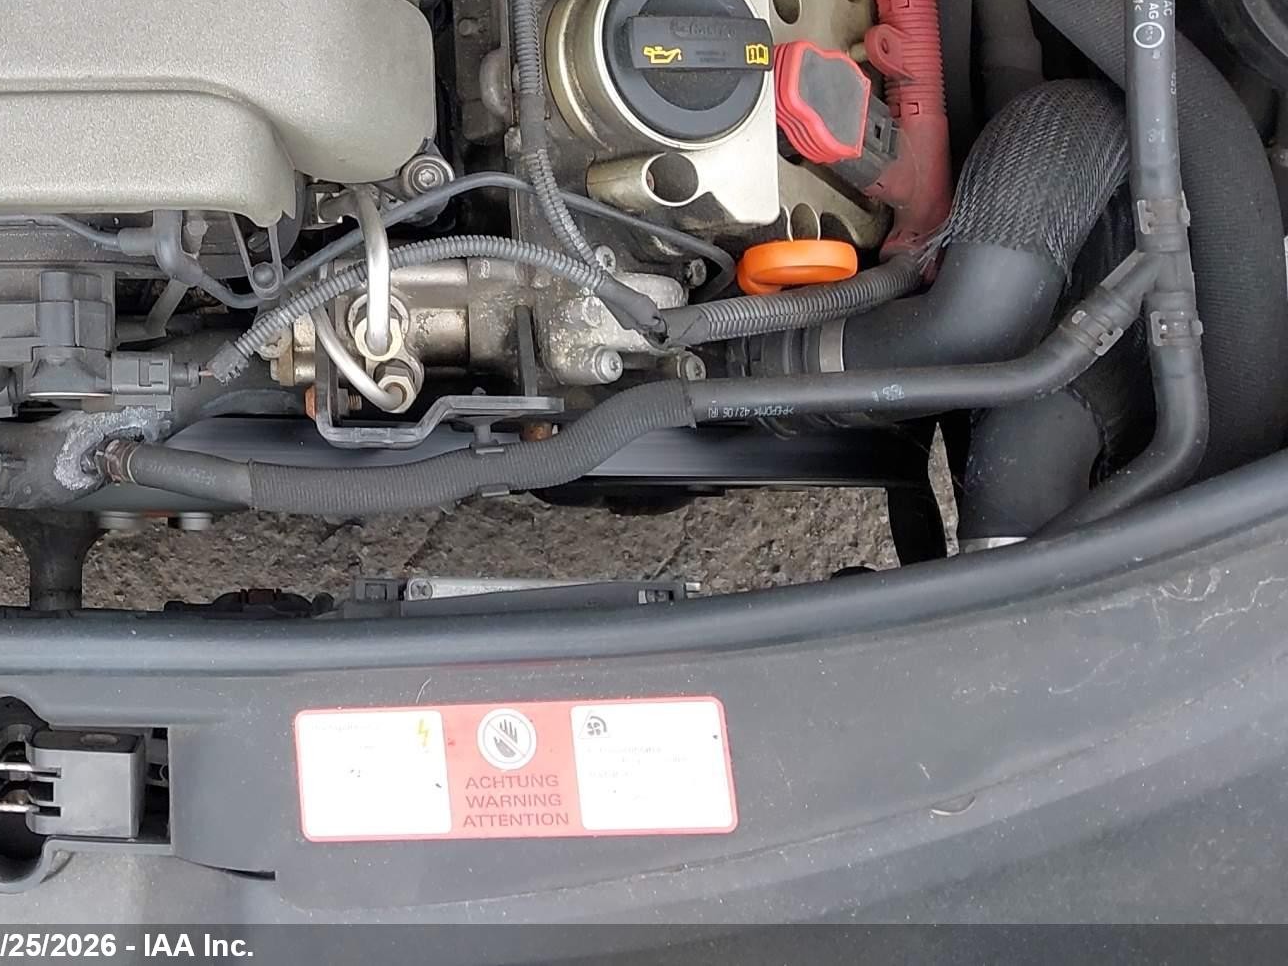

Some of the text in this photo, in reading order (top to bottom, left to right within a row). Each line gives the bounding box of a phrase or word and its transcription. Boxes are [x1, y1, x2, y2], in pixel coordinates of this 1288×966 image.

[1148, 2, 1159, 19] AG
[464, 774, 560, 791] ACHTUNG
[465, 793, 563, 810] WARNING
[462, 812, 570, 829] ATTENTION
